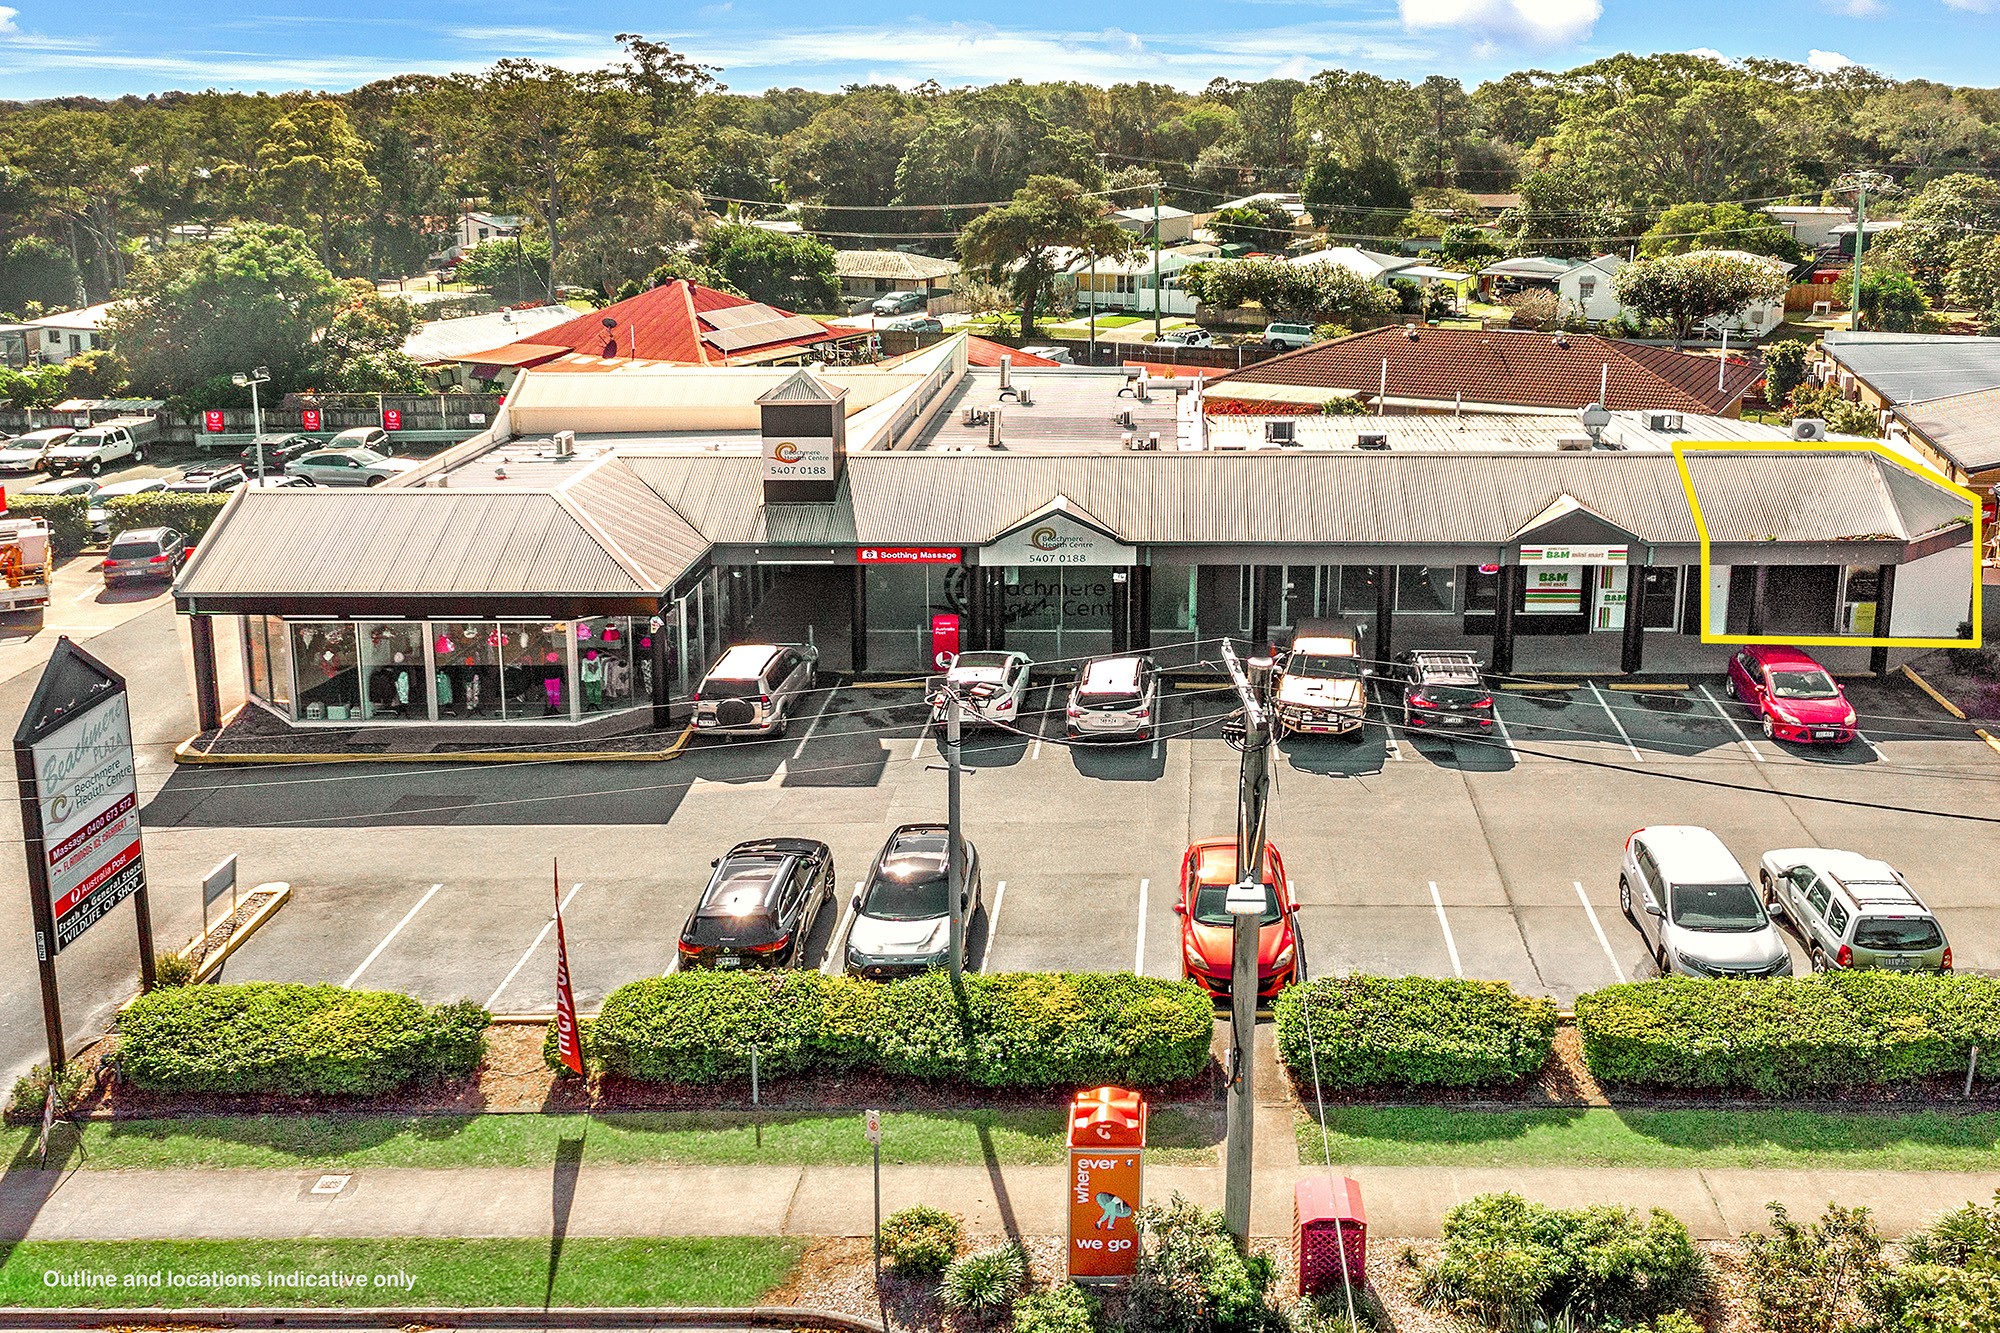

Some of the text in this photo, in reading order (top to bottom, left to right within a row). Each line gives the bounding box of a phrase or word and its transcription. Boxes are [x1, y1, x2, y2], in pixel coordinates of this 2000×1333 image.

[770, 466, 826, 475] 5407 0188
[880, 551, 957, 560] Soothing Massage
[1029, 554, 1087, 563] 5407 0188
[1546, 551, 1570, 559] B&M
[1538, 572, 1569, 582] B&M
[1063, 600, 1114, 616] Cent
[43, 699, 123, 795] Beachmere
[93, 733, 123, 763] PLAZA
[74, 760, 120, 796] Beachmere
[75, 764, 132, 809] Health Centre
[52, 797, 132, 860] Massage 0400 673 572
[81, 866, 112, 894] Australia
[111, 854, 127, 870] Post
[58, 911, 80, 932] Fresh
[90, 877, 121, 906] General
[122, 862, 142, 882] Store
[63, 907, 101, 944] WILDLIFE
[103, 895, 116, 911] OP
[117, 876, 139, 900] SHOP
[1076, 1239, 1132, 1252] we go
